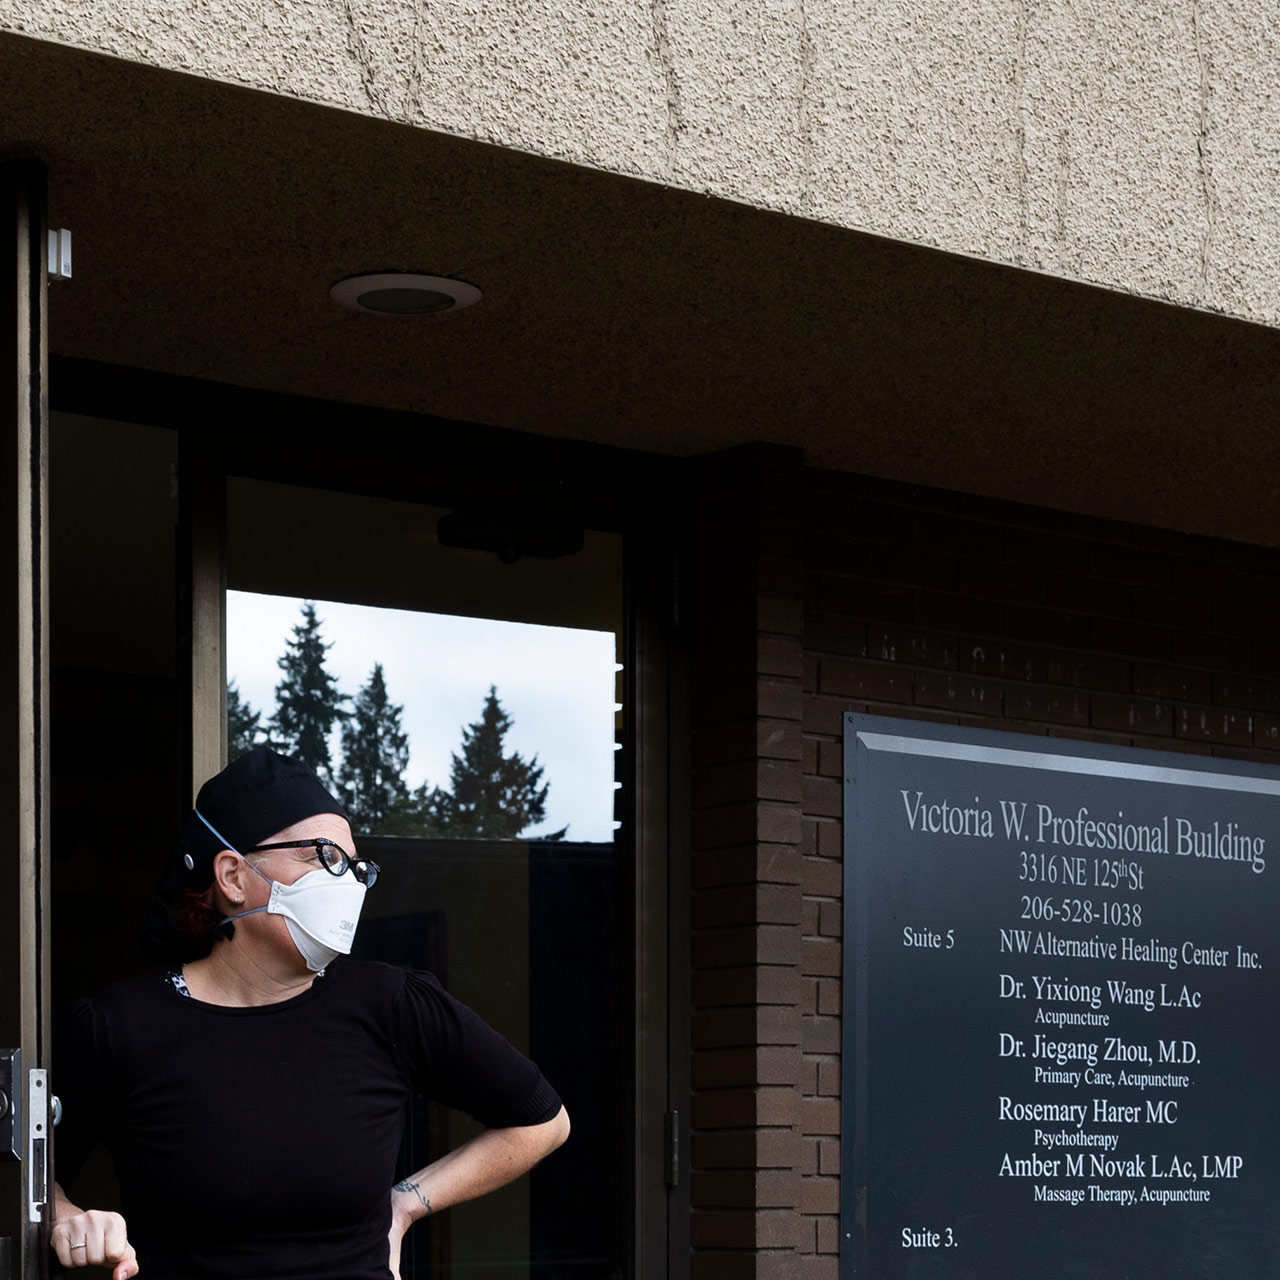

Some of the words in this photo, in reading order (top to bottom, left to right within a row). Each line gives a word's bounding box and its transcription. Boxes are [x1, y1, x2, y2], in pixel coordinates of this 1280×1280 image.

[900, 790, 994, 838] Victoria
[999, 800, 1029, 841] W.
[1037, 804, 1169, 854] Professional
[1175, 818, 1265, 873] Building
[1019, 851, 1057, 883] 3316
[1062, 856, 1087, 886] NE
[1021, 895, 1142, 927] 206-528-1038
[339, 920, 354, 932] 3M
[903, 926, 941, 948] Suite
[946, 929, 954, 949] 5
[1000, 929, 1032, 953] NW
[1033, 932, 1117, 959] Alternative
[1121, 937, 1178, 970] Healing
[1182, 941, 1229, 966] Center
[1237, 945, 1262, 969] Inc.
[1000, 974, 1026, 999] Dr.
[1032, 976, 1102, 1009] Yixiong
[1107, 980, 1155, 1012] Wang
[1160, 984, 1201, 1008] L.Ac
[1035, 1008, 1109, 1028] Acupuncture
[999, 1033, 1026, 1057] Dr.
[1032, 1034, 1098, 1066] Jiegang
[1103, 1038, 1153, 1066] Zhou,
[1159, 1040, 1200, 1064] M.D.
[1035, 1066, 1081, 1088] Primary
[1084, 1068, 1115, 1087] Care,
[1118, 1070, 1189, 1090] Acupuncture
[999, 1097, 1087, 1128] Rosemary
[1093, 1099, 1141, 1123] Harer
[1146, 1101, 1177, 1124] MC
[1034, 1129, 1119, 1151] Psychotherapy
[999, 1153, 1061, 1177] Amber
[1066, 1154, 1084, 1177] M
[1089, 1154, 1146, 1177] Novak
[1151, 1155, 1197, 1182] L.Ac,
[1203, 1156, 1243, 1178] LMP
[1034, 1185, 1085, 1206] Massage
[1088, 1185, 1137, 1206] Therapy,
[1140, 1186, 1210, 1206] Acupuncture
[902, 1227, 940, 1247] Suite
[945, 1227, 958, 1247] 3.
